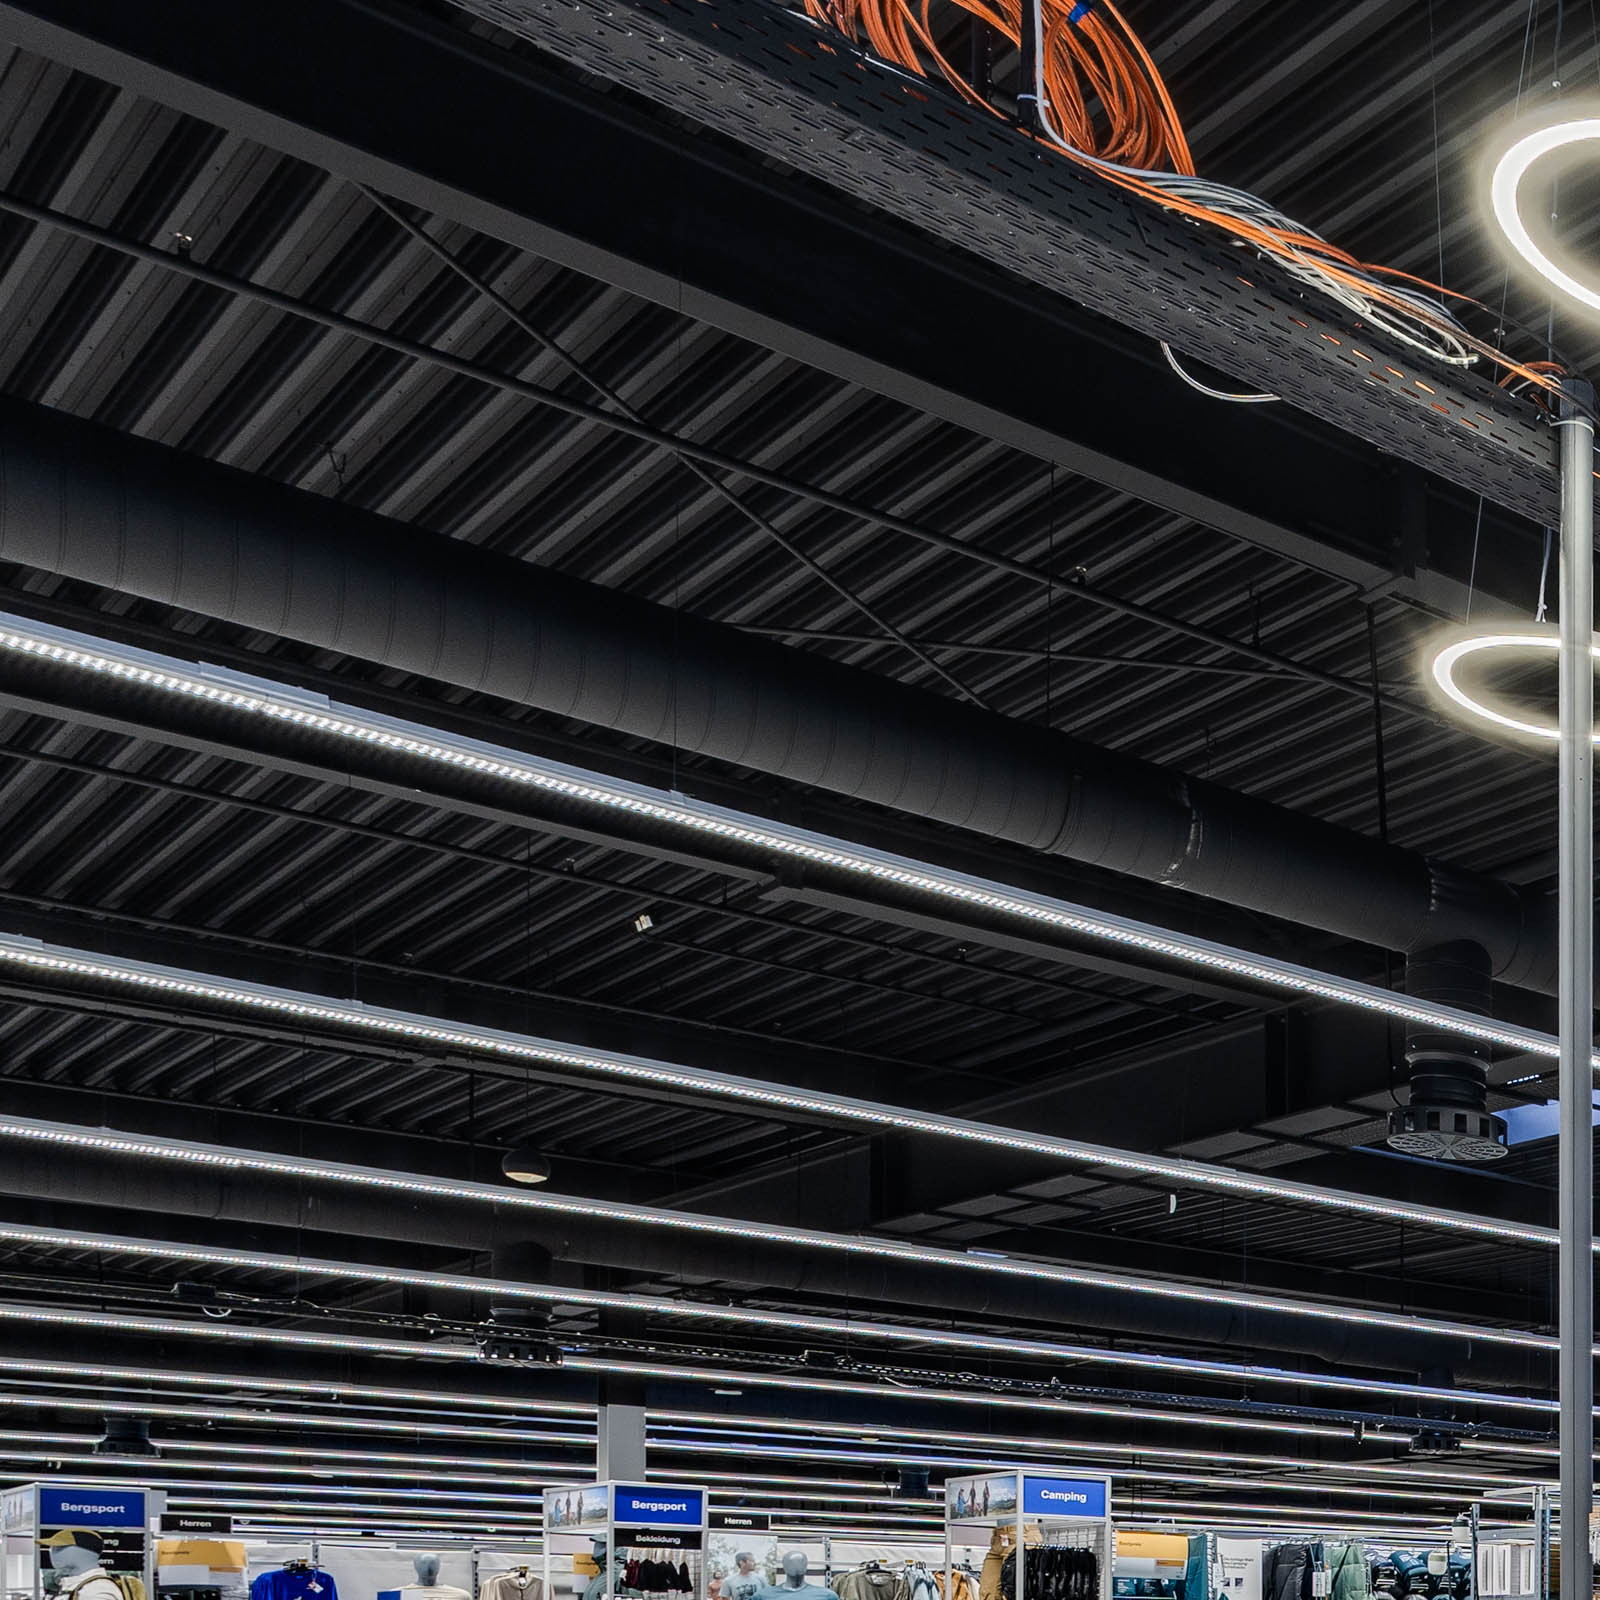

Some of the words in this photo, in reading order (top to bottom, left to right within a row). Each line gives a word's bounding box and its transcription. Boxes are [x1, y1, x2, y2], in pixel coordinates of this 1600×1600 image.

[1040, 1489, 1087, 1504] Camping
[60, 1502, 126, 1514] Bergsport
[631, 1500, 687, 1512] Bergsport
[179, 1519, 212, 1528] Herren
[724, 1516, 752, 1526] Herren
[635, 1534, 681, 1545] Bekleidung
